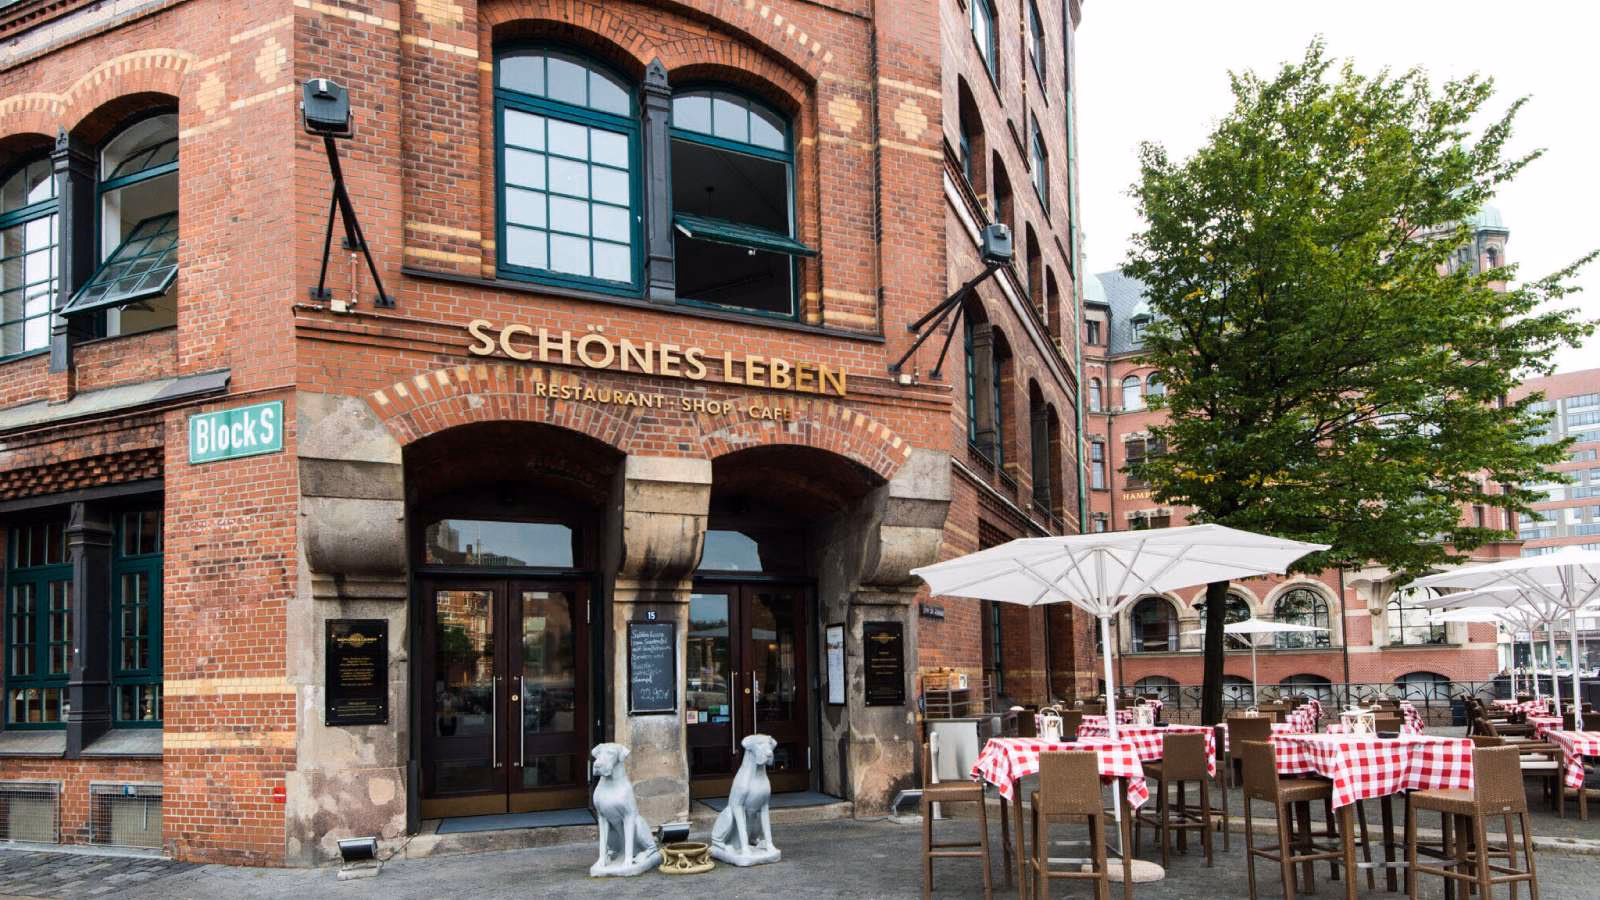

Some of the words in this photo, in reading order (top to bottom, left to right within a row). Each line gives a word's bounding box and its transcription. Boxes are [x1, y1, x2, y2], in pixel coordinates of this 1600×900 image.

[468, 319, 706, 380] SCHÖNES
[723, 351, 847, 396] LEBEN
[535, 382, 665, 409] RESTAURANT
[682, 397, 732, 415] SHOP
[196, 411, 257, 454] Block
[260, 407, 274, 445] S
[647, 611, 656, 620] 15
